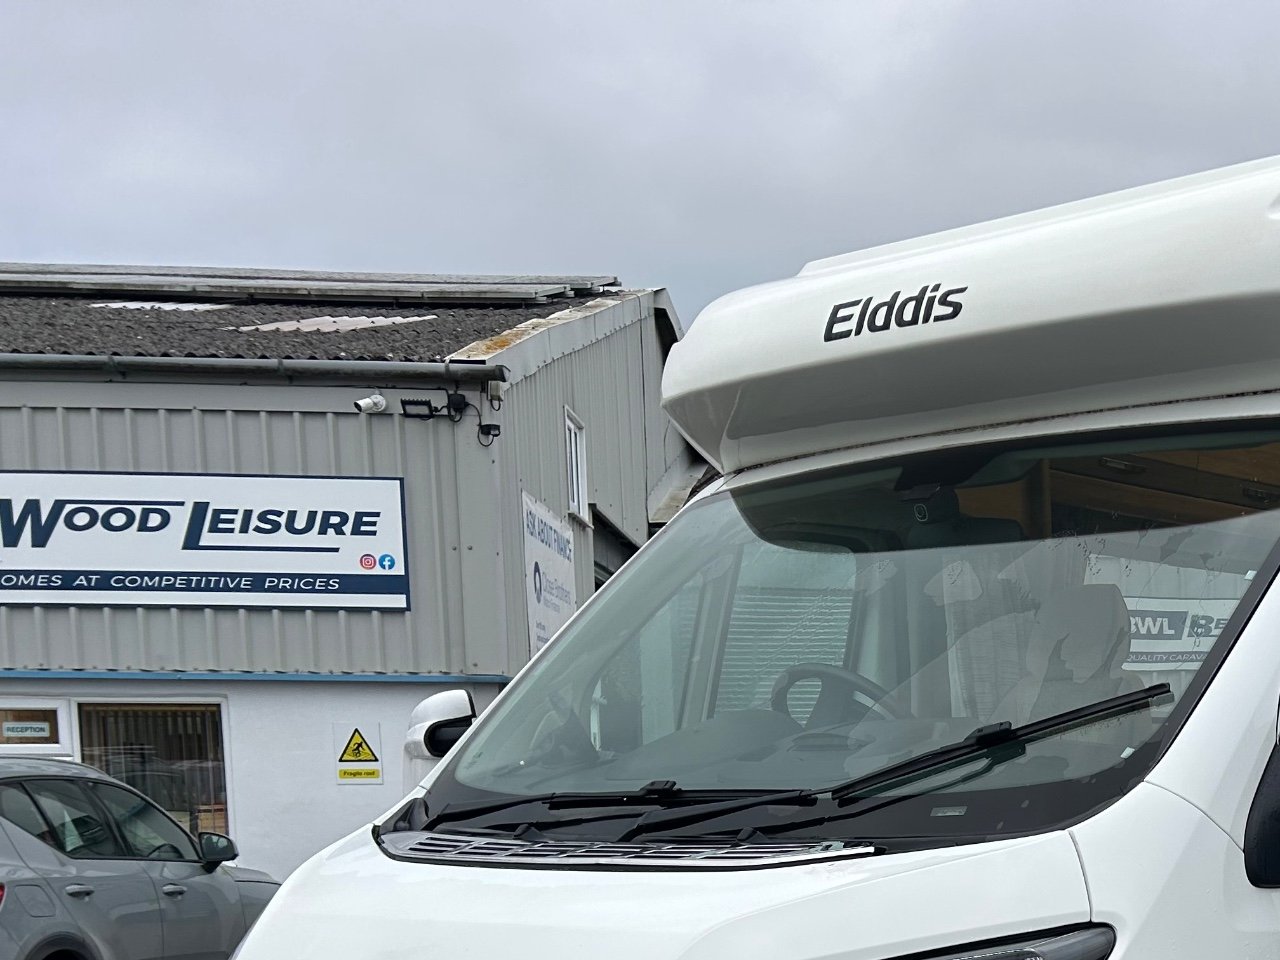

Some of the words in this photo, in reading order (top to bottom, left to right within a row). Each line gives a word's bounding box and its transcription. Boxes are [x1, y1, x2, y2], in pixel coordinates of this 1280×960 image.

[824, 283, 968, 342] Elddis
[182, 501, 381, 552] LEISURE
[73, 575, 100, 587] AT
[110, 576, 253, 588] COMPETITIVE
[264, 578, 340, 590] PRICES
